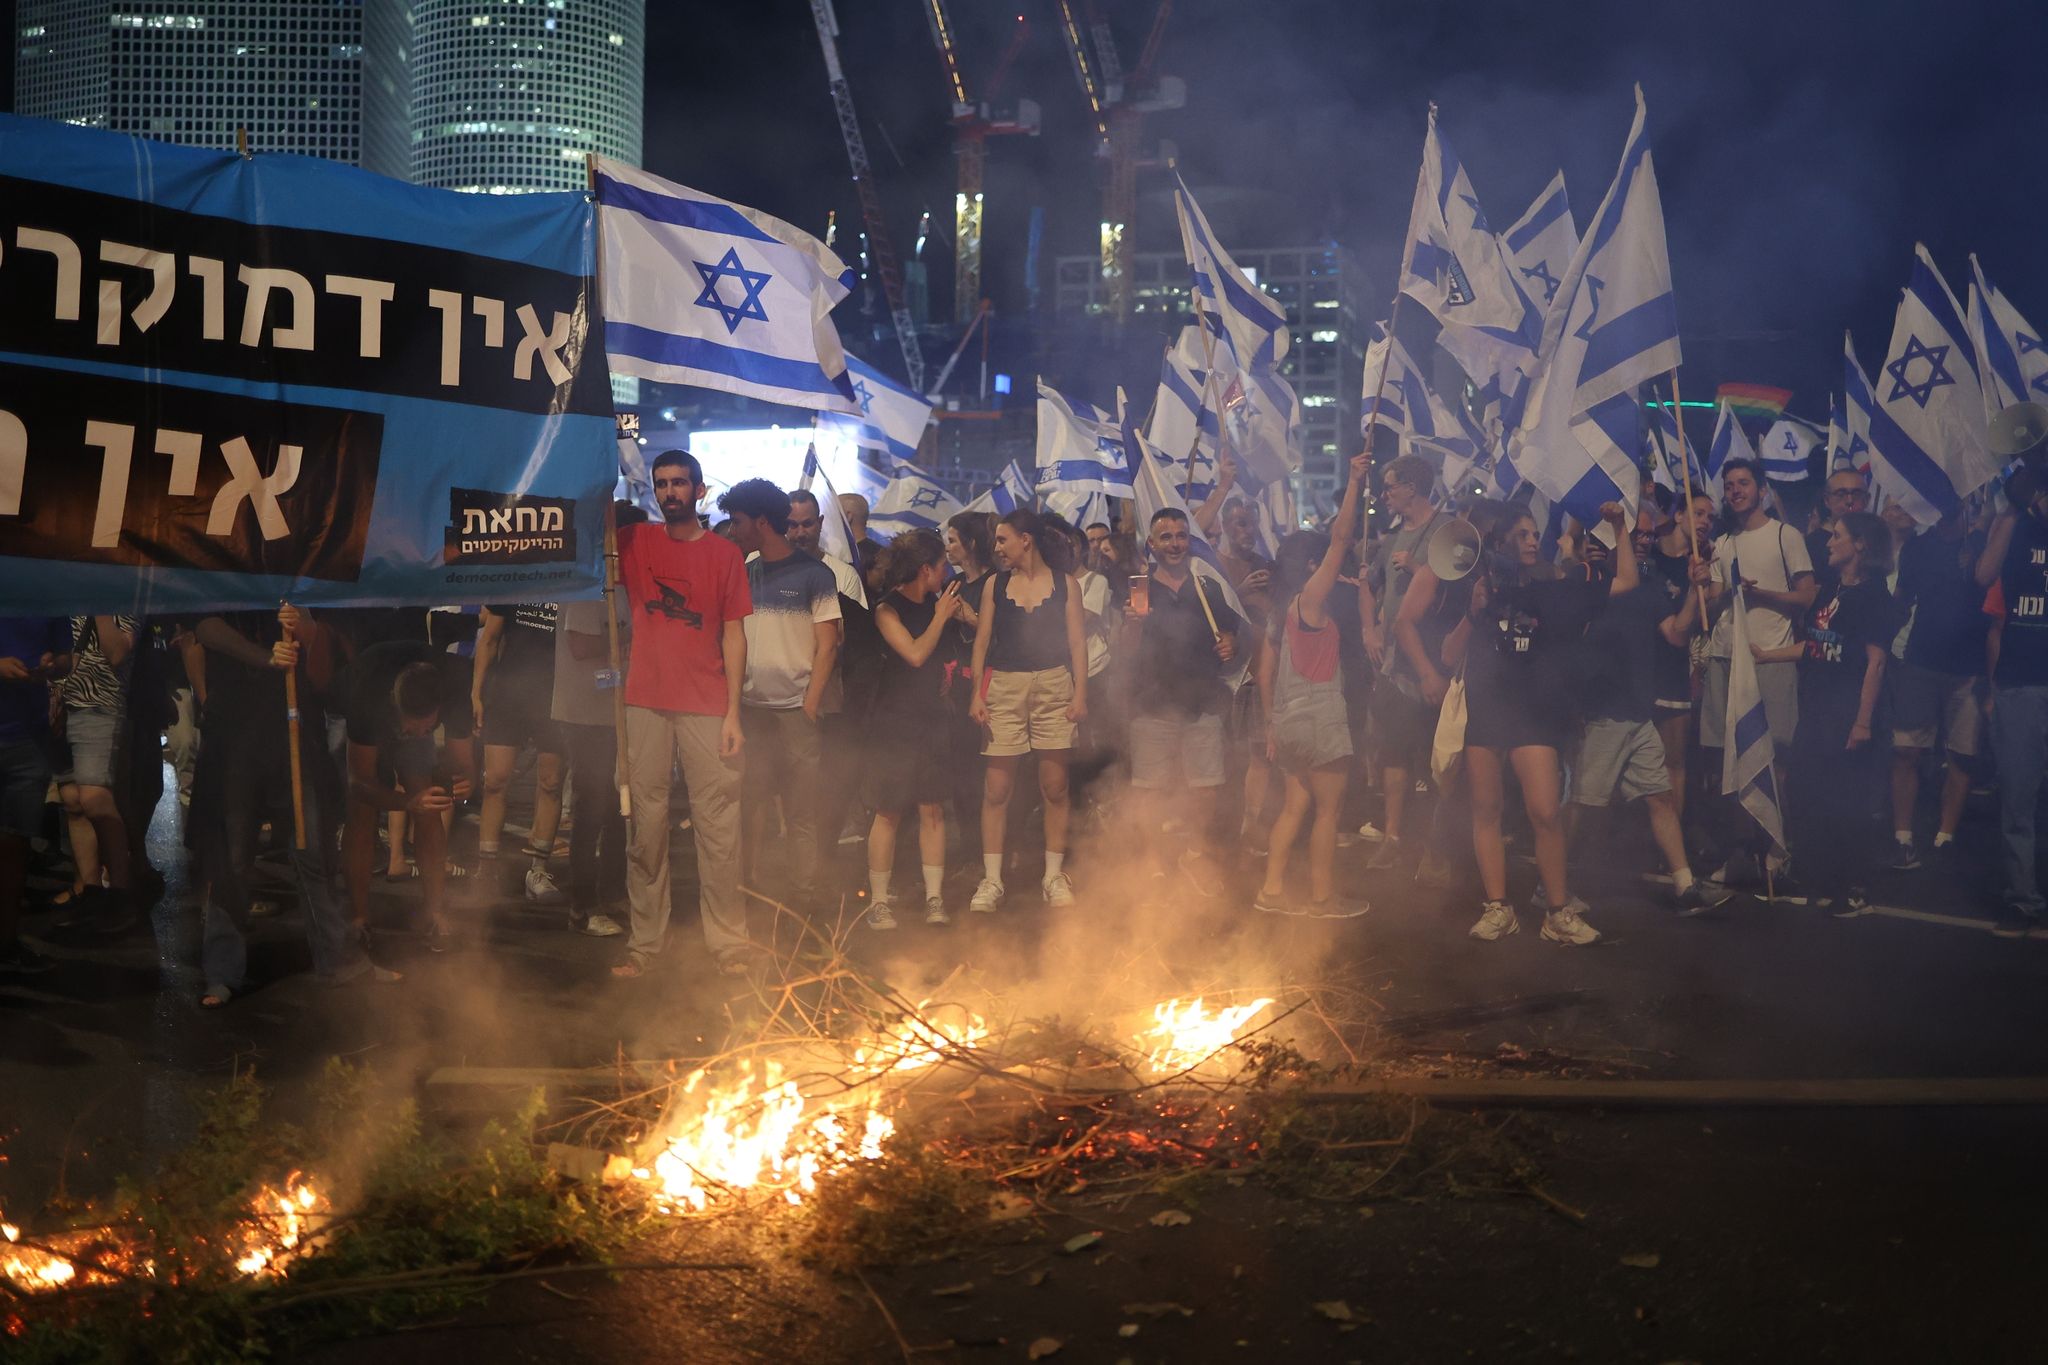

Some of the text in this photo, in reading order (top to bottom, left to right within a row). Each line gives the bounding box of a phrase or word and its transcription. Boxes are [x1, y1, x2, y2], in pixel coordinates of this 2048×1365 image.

[0, 226, 573, 387] אין דמוקר
[84, 419, 304, 549] אין
[461, 505, 564, 535] מחאת
[461, 537, 564, 554] ההייטקיסטים
[445, 570, 573, 584] democratech.net
